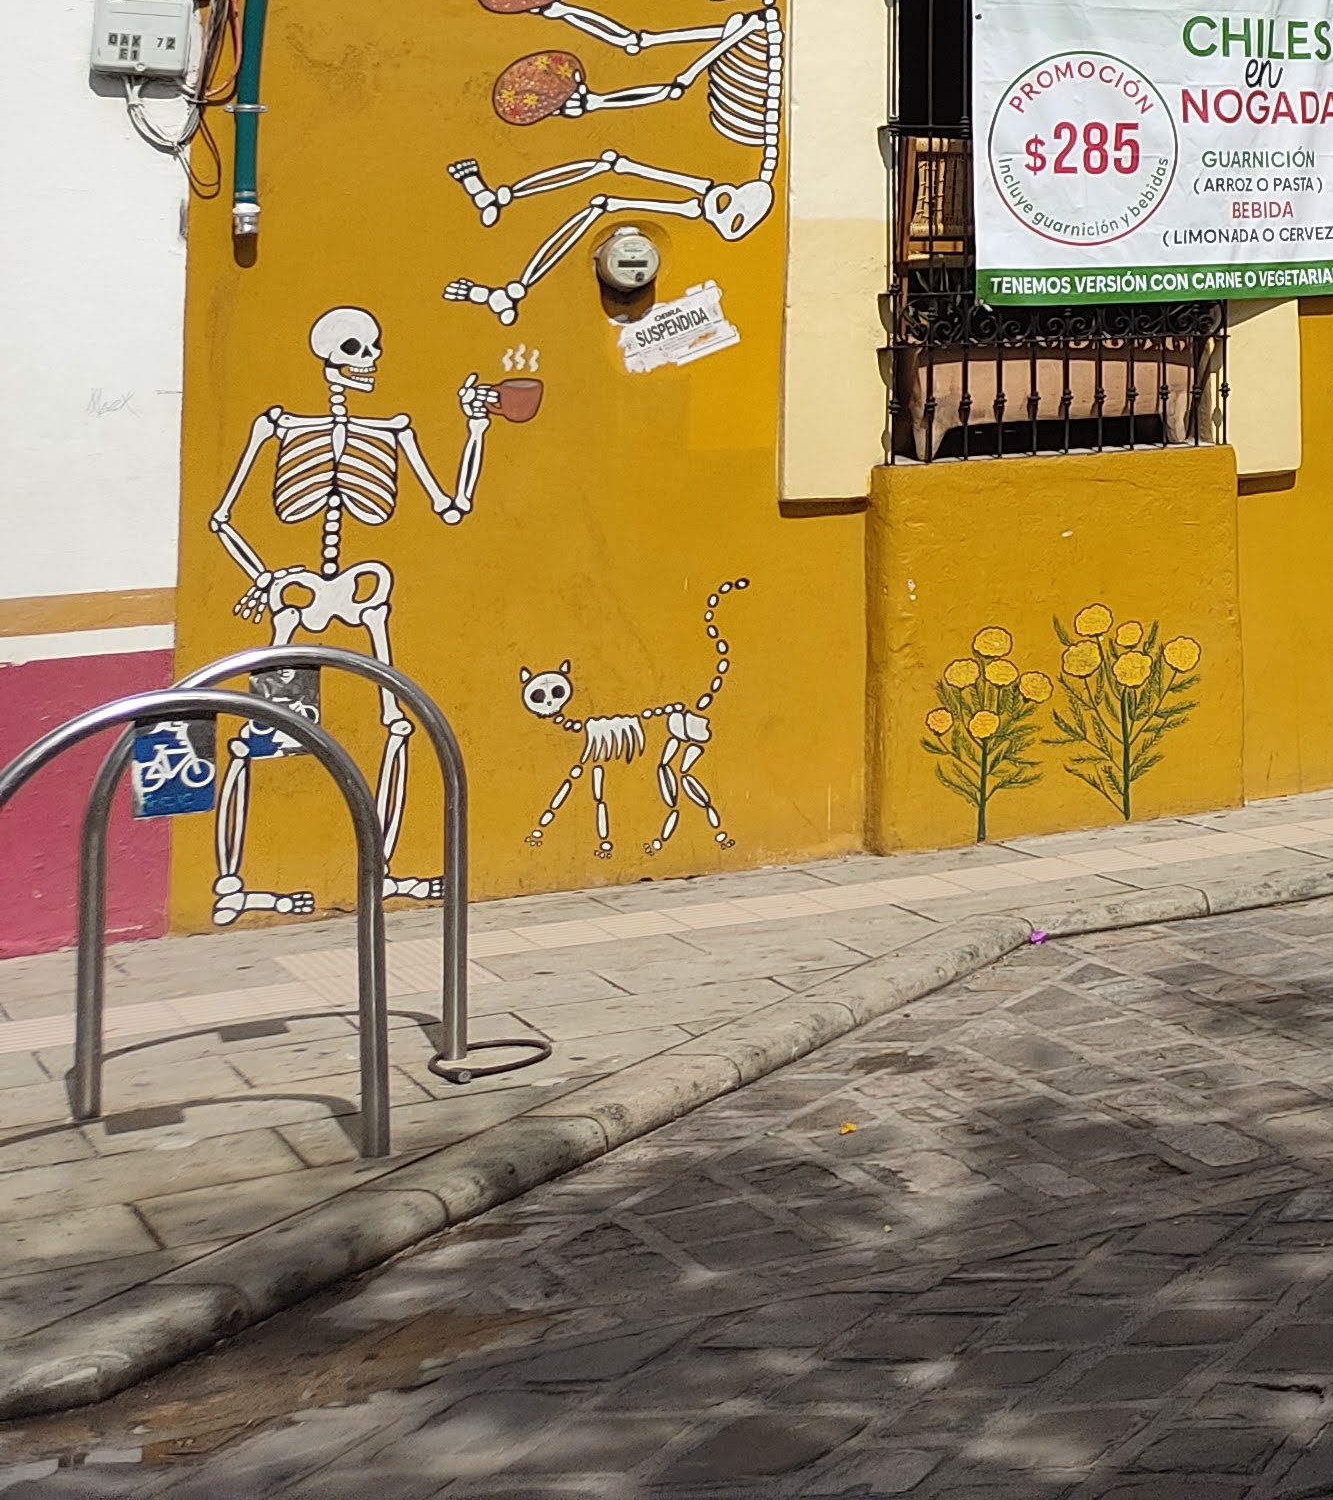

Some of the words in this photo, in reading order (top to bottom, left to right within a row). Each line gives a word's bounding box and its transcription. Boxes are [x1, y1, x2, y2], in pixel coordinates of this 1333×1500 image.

[157, 36, 176, 50] 72
[1182, 15, 1332, 61] CHILES
[1244, 59, 1284, 89] en
[1008, 60, 1155, 116] PROMOCIÓN
[1024, 120, 1141, 177] $285
[1201, 146, 1316, 169] GUARNICIÓN
[1256, 177, 1269, 192] O
[998, 156, 1035, 218] Incluye
[1031, 207, 1120, 239] guarnición
[1120, 212, 1133, 232] y
[1128, 156, 1170, 220] bebidas
[1232, 201, 1294, 219] BEBIDA
[1262, 227, 1275, 242] O
[991, 274, 1070, 296] TENEMOS
[1073, 271, 1147, 294] VERSIÓN
[1148, 273, 1190, 293] CON
[1192, 271, 1242, 292] CARNE
[1244, 271, 1257, 289] O
[654, 307, 682, 322] OBRA
[635, 307, 710, 348] SUSPENDIDA
